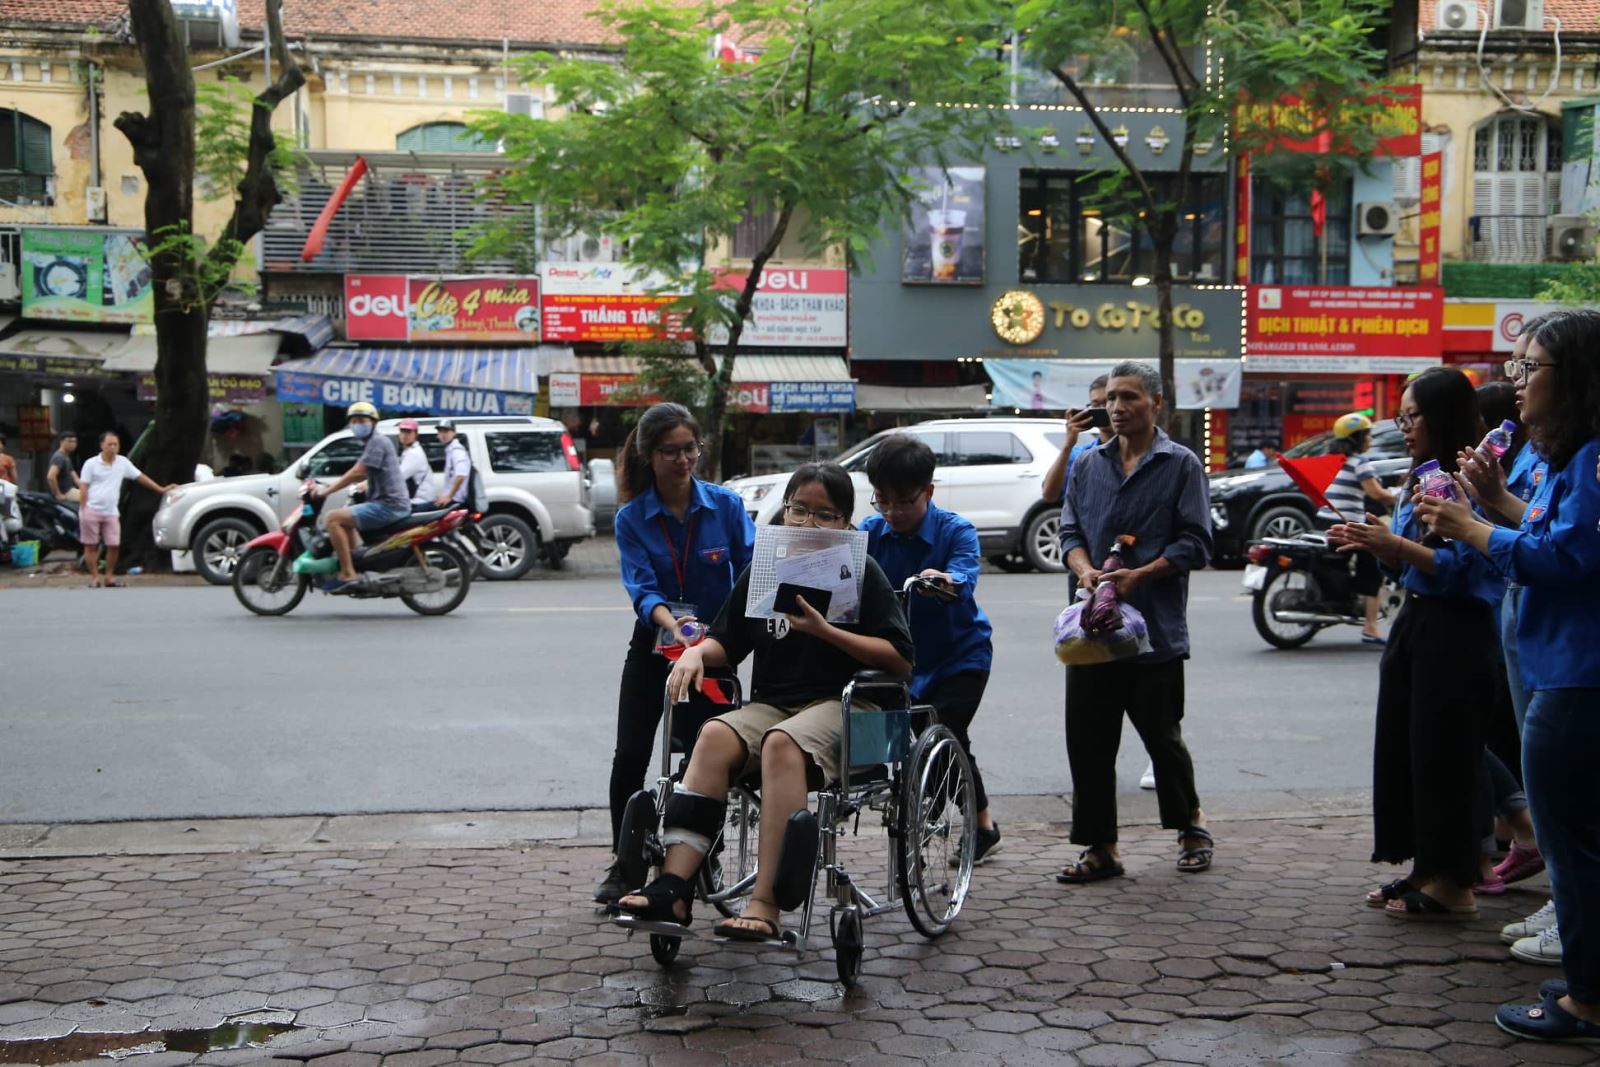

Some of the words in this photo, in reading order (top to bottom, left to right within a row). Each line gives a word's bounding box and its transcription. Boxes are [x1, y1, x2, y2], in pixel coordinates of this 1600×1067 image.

[1258, 317, 1290, 335] DỊCH
[1293, 314, 1337, 336] THUẬT
[1339, 318, 1348, 333] &
[1352, 315, 1393, 335] PHIÊN
[1396, 318, 1429, 337] DỊCH
